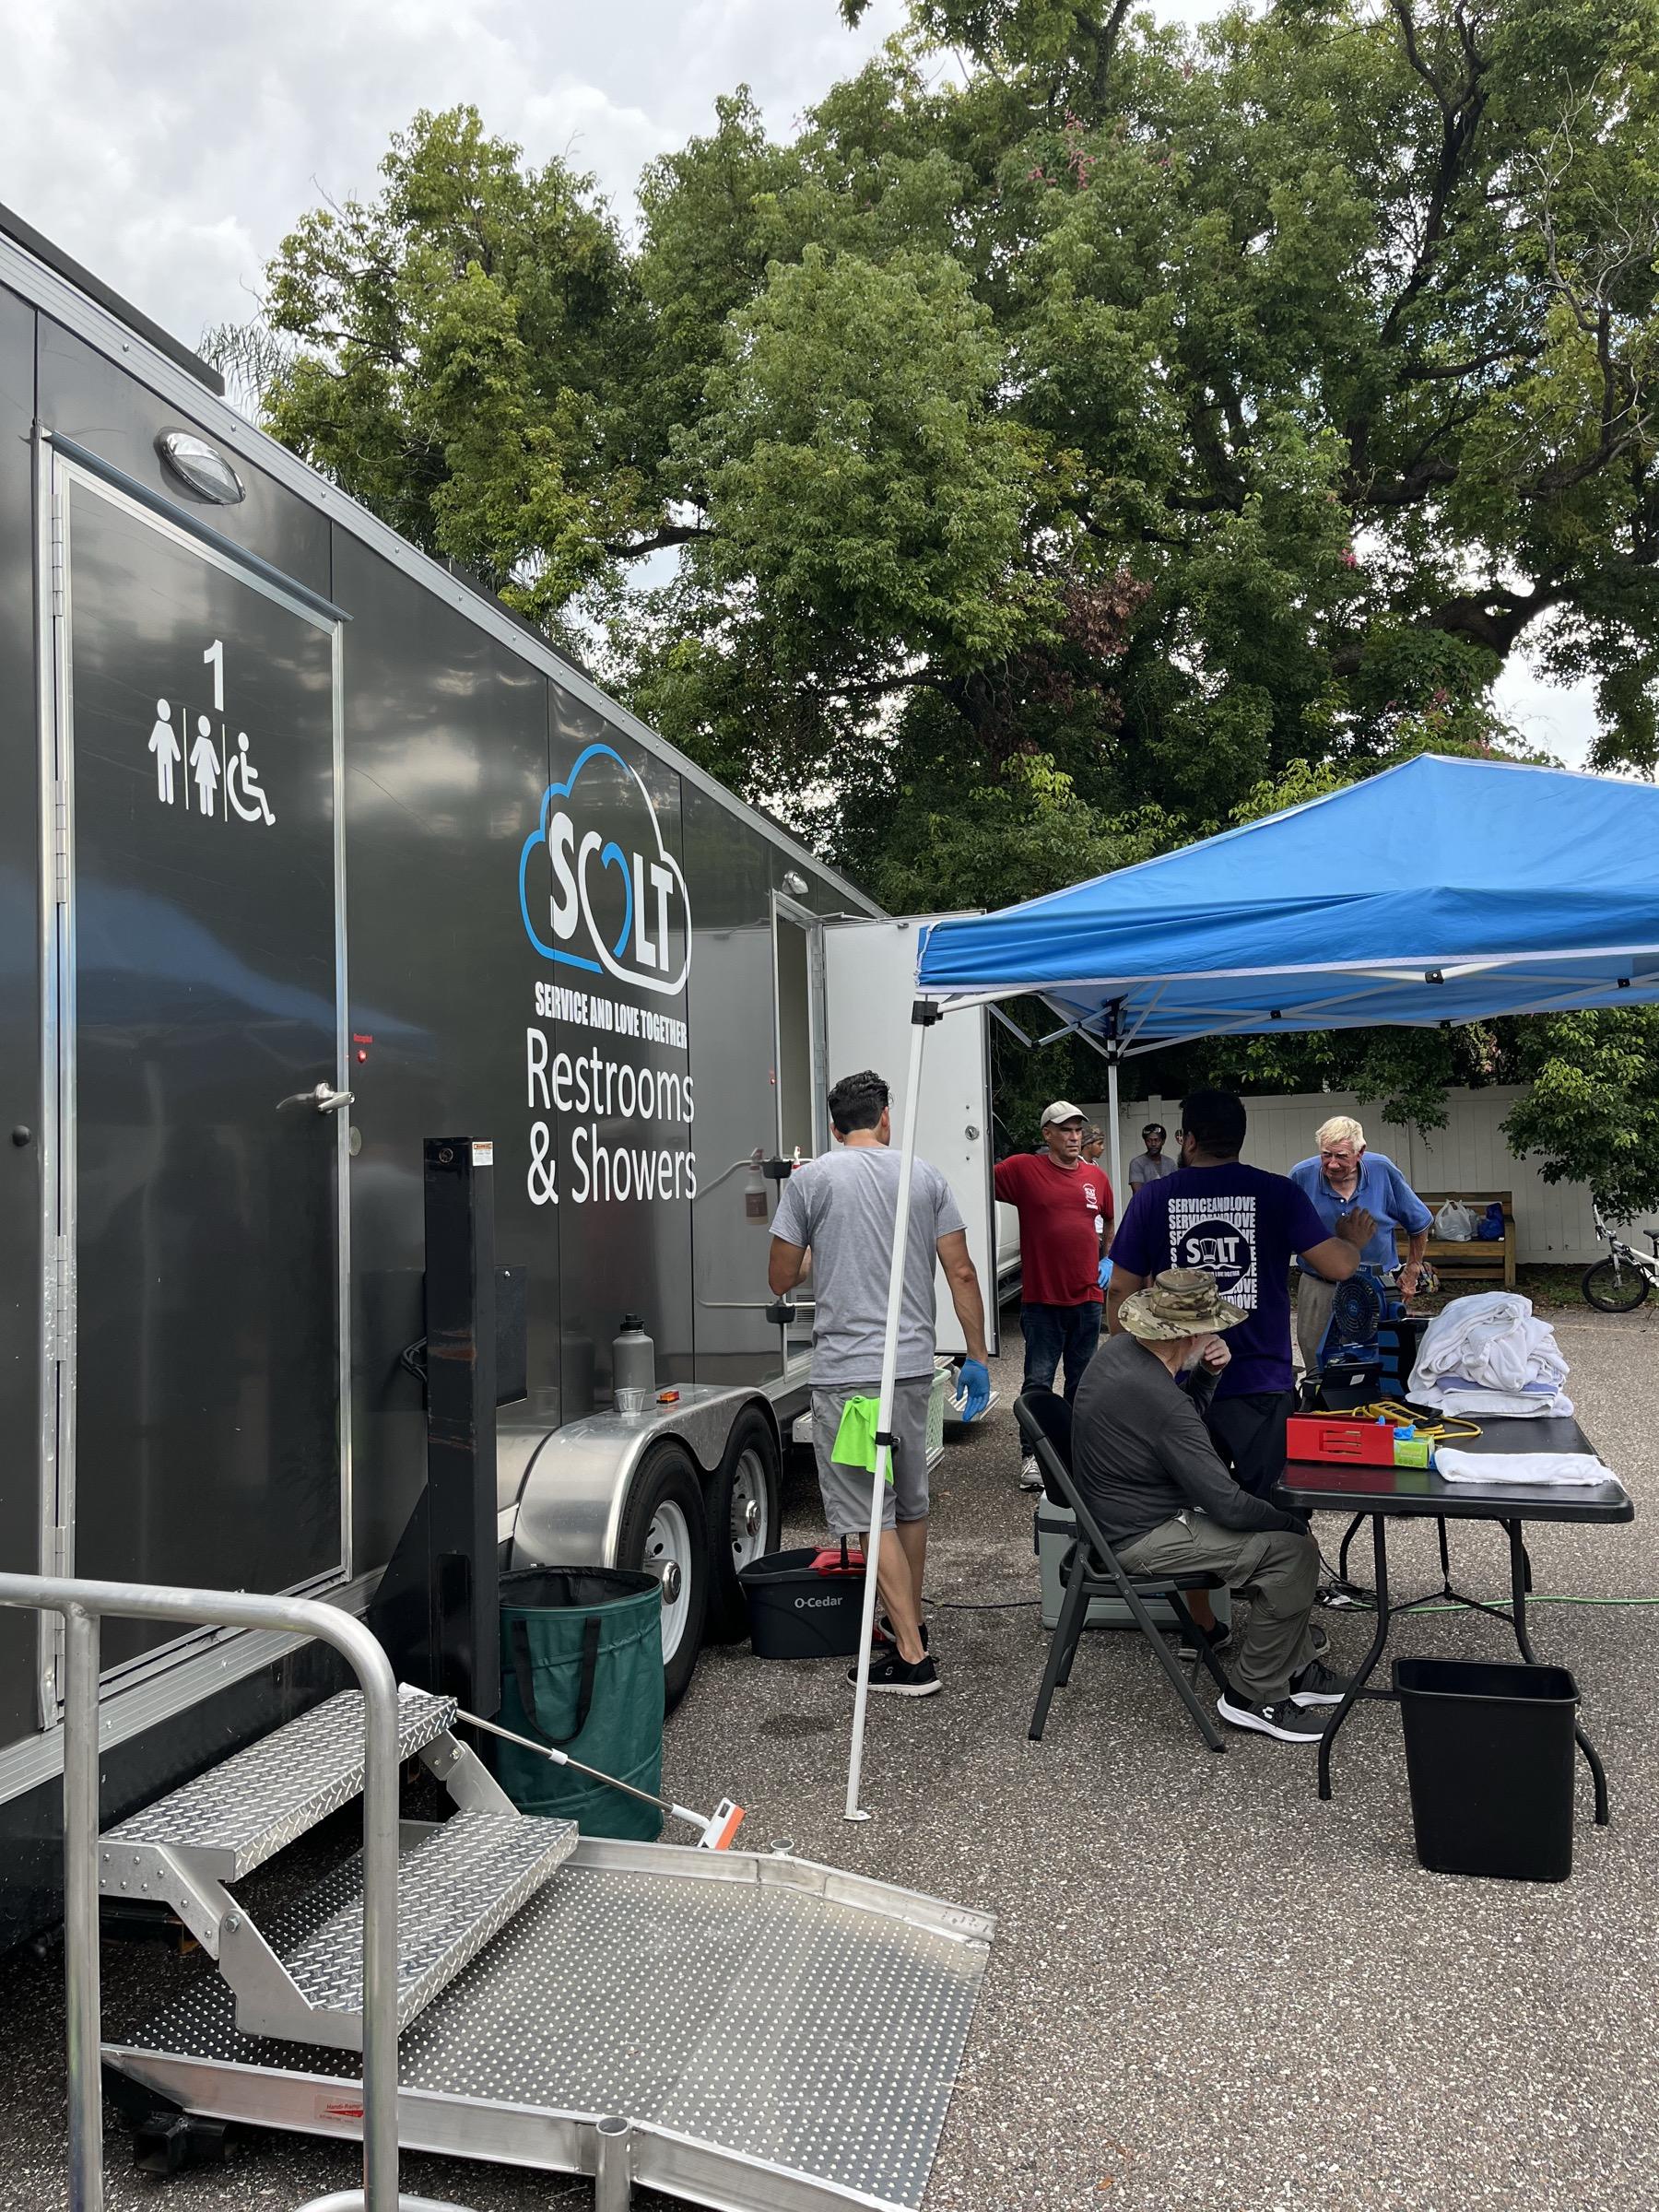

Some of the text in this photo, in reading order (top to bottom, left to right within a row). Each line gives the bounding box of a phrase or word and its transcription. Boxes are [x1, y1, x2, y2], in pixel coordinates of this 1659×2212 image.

[204, 639, 224, 712] 1
[535, 981, 688, 1049] SERVICE AND LOVE TOGETHER
[527, 1027, 695, 1124] Restrooms
[527, 1121, 697, 1206] & Showers
[794, 1595, 843, 1608] O-Cedar
